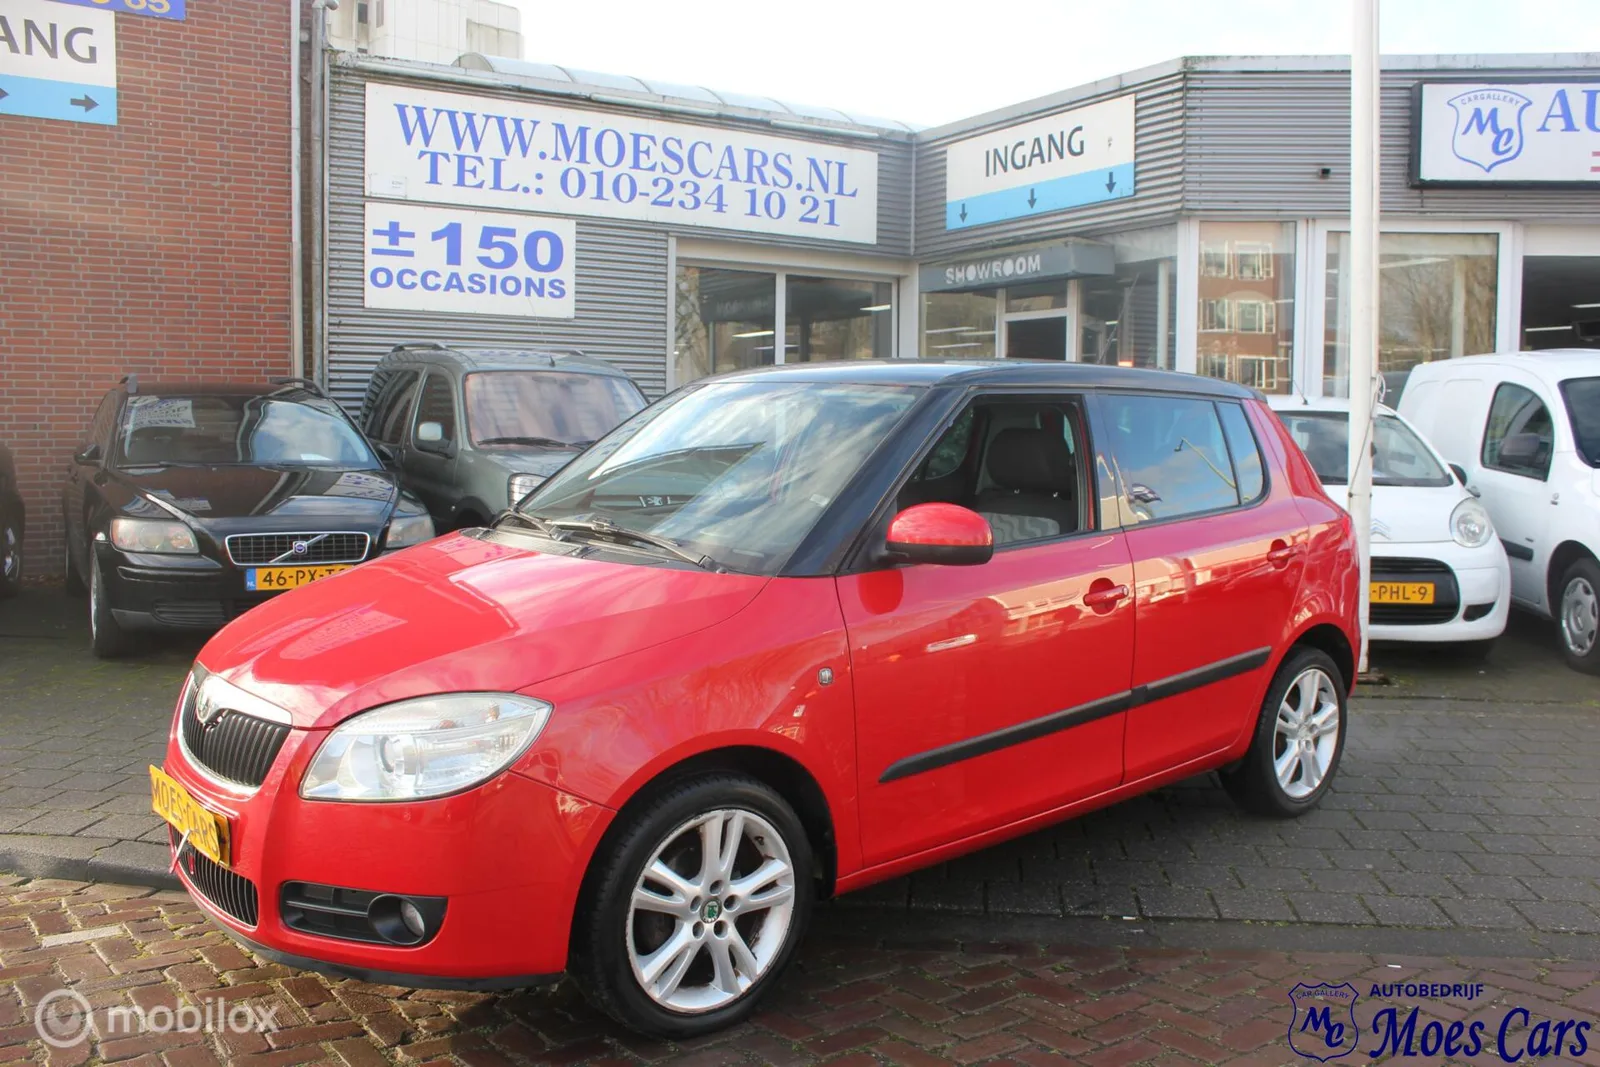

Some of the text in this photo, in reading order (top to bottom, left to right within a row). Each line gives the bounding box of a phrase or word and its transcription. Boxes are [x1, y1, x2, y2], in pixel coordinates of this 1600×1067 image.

[393, 103, 858, 198] WWW.MOESCARS.NL
[985, 125, 1085, 177] INGANG
[417, 150, 840, 227] TEL.: 010-234 10 21
[431, 222, 564, 273] 150
[945, 254, 1041, 285] SHOWROOM
[370, 267, 566, 299] OCCASIONS
[262, 567, 346, 587] 46-PX-T
